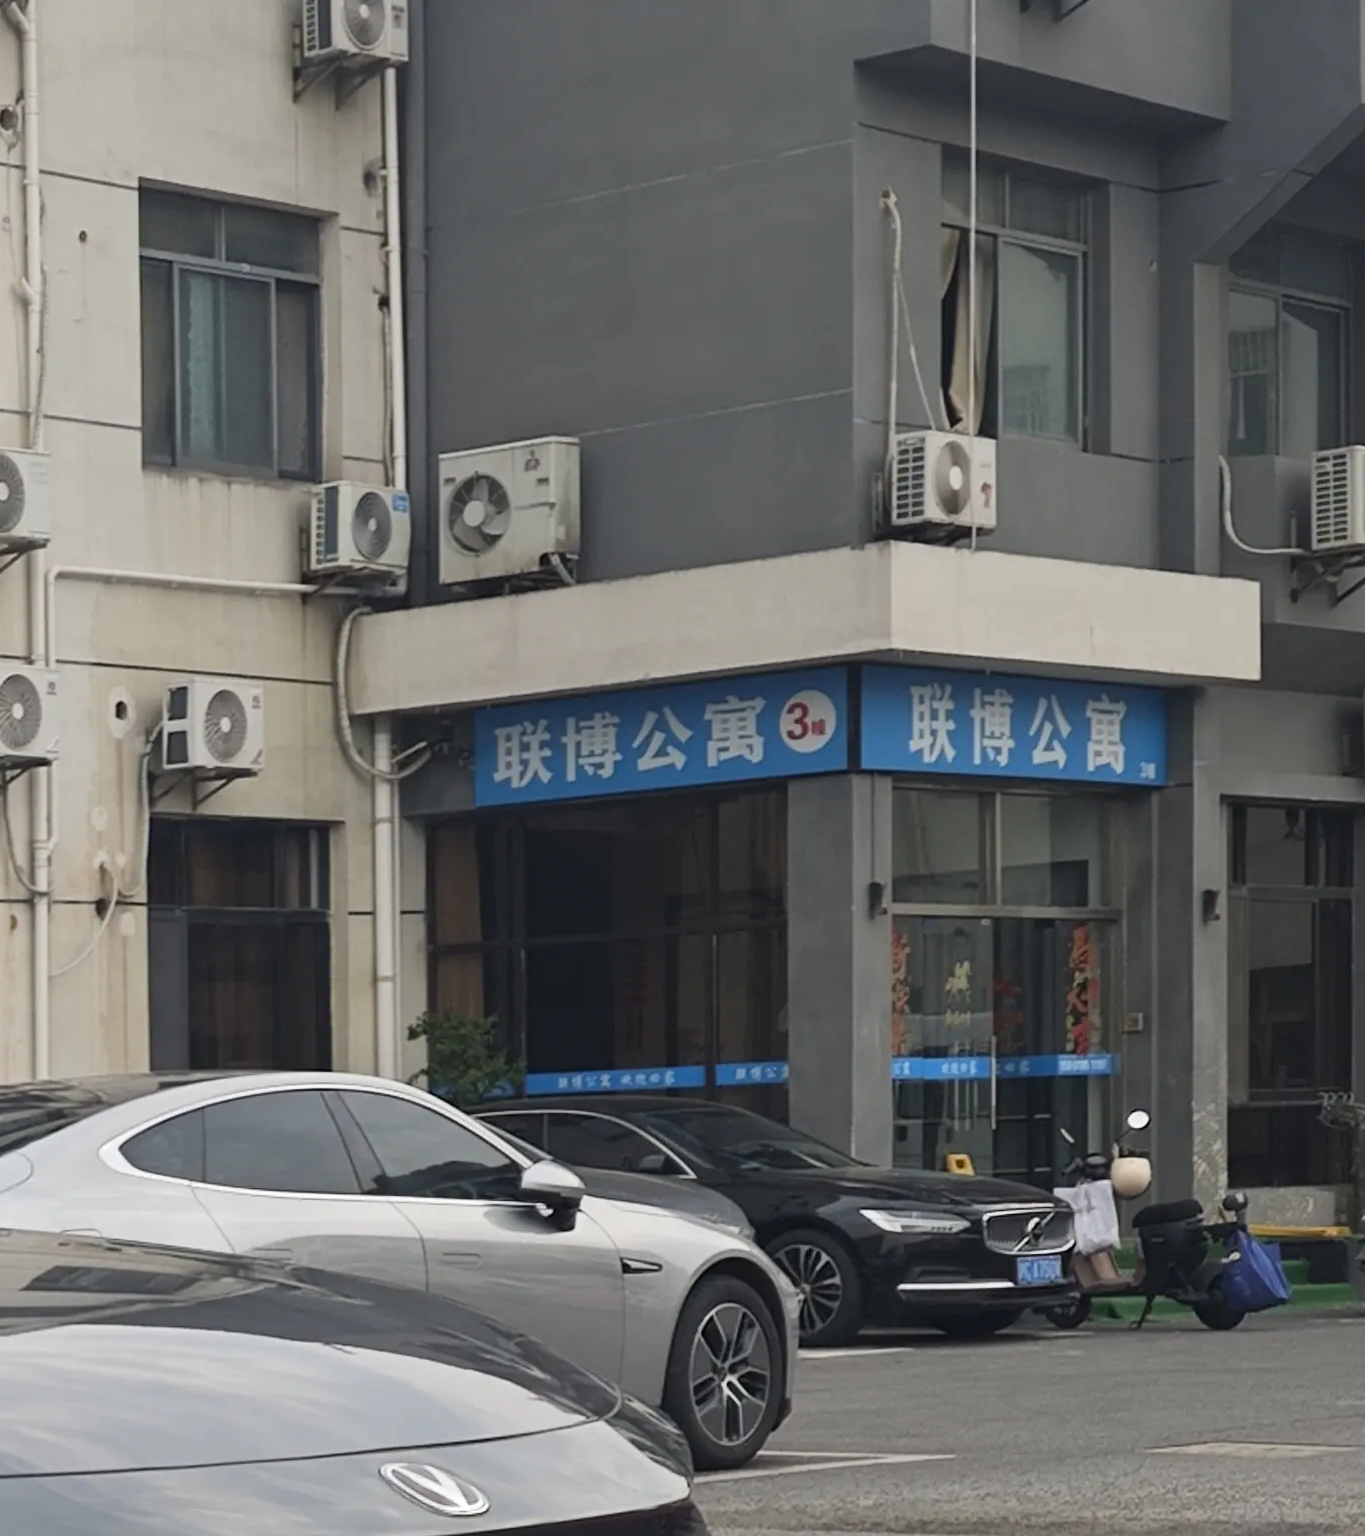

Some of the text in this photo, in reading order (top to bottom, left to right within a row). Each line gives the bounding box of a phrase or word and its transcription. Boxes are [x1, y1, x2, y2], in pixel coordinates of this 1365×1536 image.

[493, 695, 766, 789] 联博公寓
[909, 682, 1126, 775] 联博公寓
